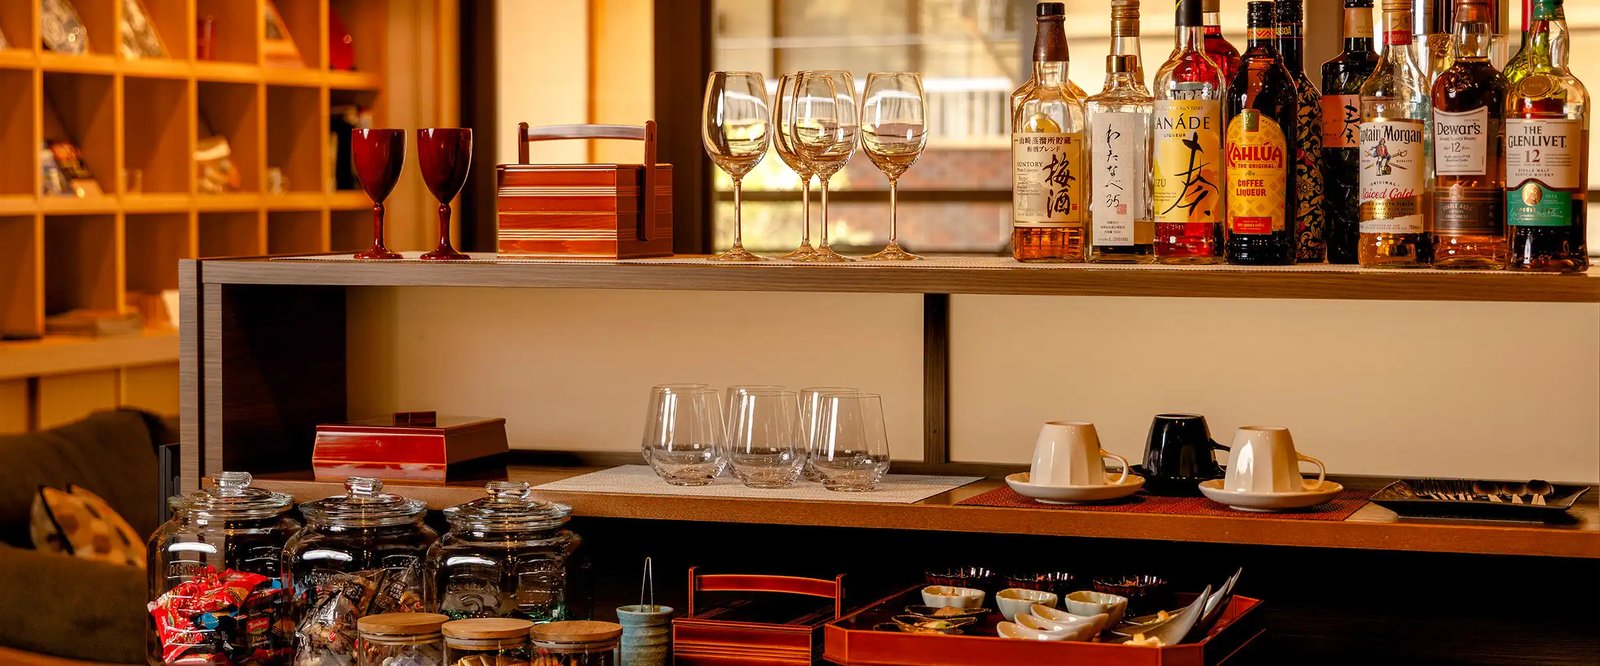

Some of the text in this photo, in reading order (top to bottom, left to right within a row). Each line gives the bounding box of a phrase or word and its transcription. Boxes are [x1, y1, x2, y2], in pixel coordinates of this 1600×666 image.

[1154, 113, 1210, 130] ANÁDE
[1382, 125, 1422, 145] Morgan
[1437, 122, 1481, 136] Dewar's
[1523, 125, 1543, 135] THE
[1451, 141, 1461, 153] 12
[1228, 140, 1283, 169] KAHLÚA
[1525, 148, 1540, 163] 12
[1161, 131, 1219, 217] 奏
[1042, 151, 1076, 218] 梅酒
[1237, 179, 1264, 188] COFFEE
[1236, 188, 1267, 197] LIQUEUR
[1388, 187, 1414, 200] Gold
